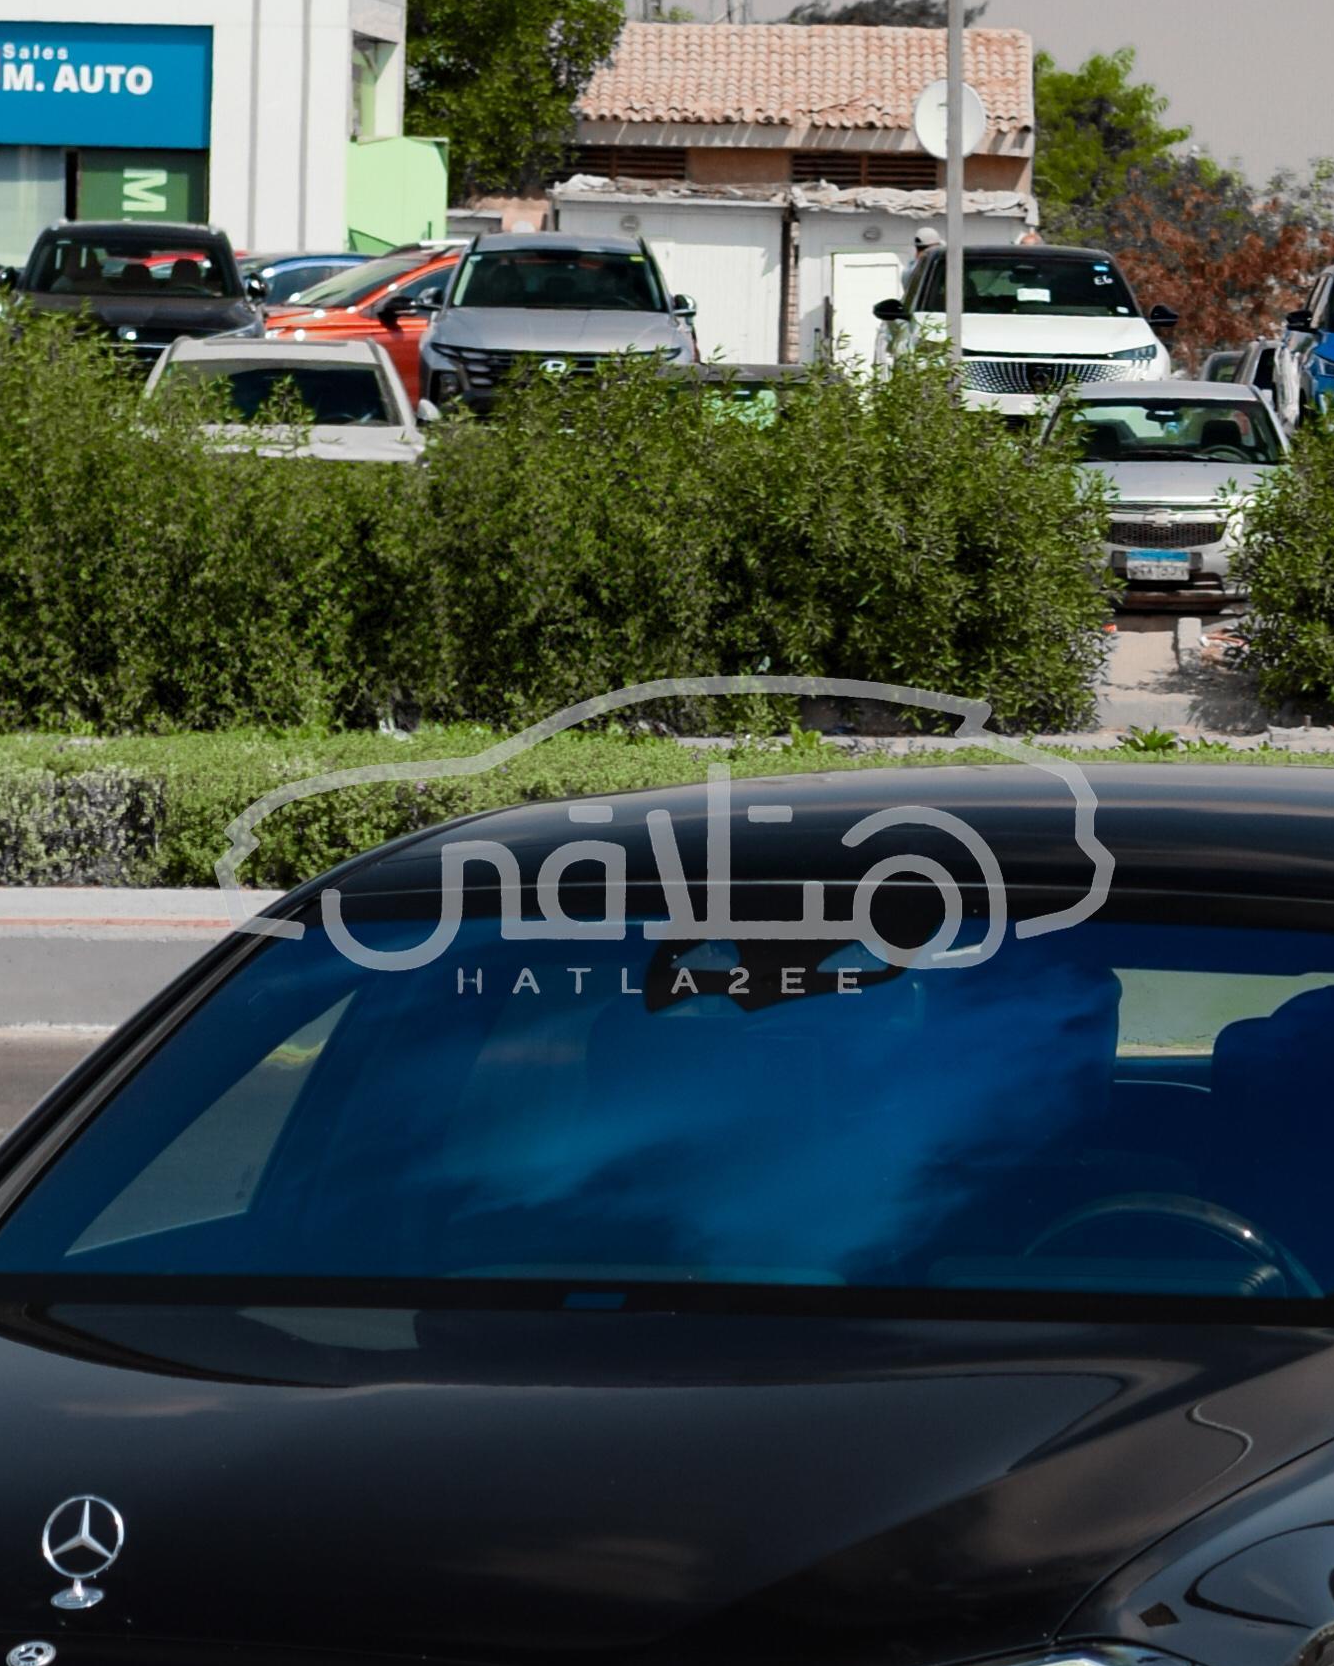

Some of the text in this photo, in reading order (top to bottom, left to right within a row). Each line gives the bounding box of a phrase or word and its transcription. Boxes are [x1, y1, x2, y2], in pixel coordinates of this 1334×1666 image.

[2, 42, 68, 61] Sales
[2, 63, 153, 95] M. AUTO
